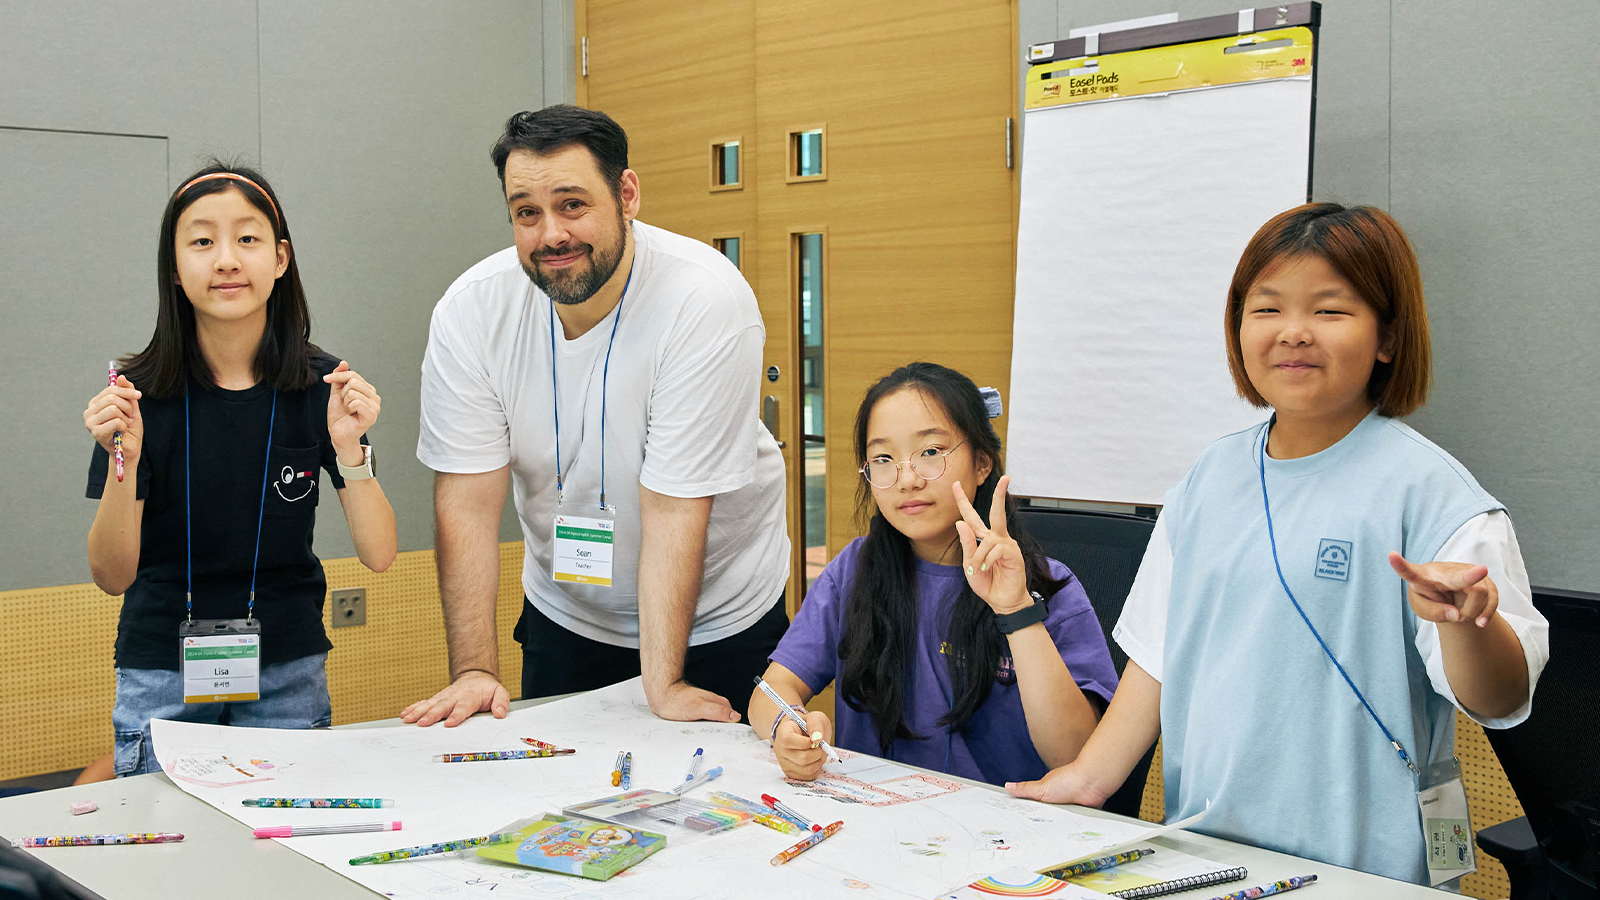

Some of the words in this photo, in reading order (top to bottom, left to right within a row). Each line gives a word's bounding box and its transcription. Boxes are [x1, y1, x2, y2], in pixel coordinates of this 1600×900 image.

[1292, 58, 1305, 67] 3M
[1070, 75, 1094, 88] Easel
[1096, 72, 1119, 85] Pads
[576, 548, 592, 558] Sean
[214, 668, 229, 676] Lisa
